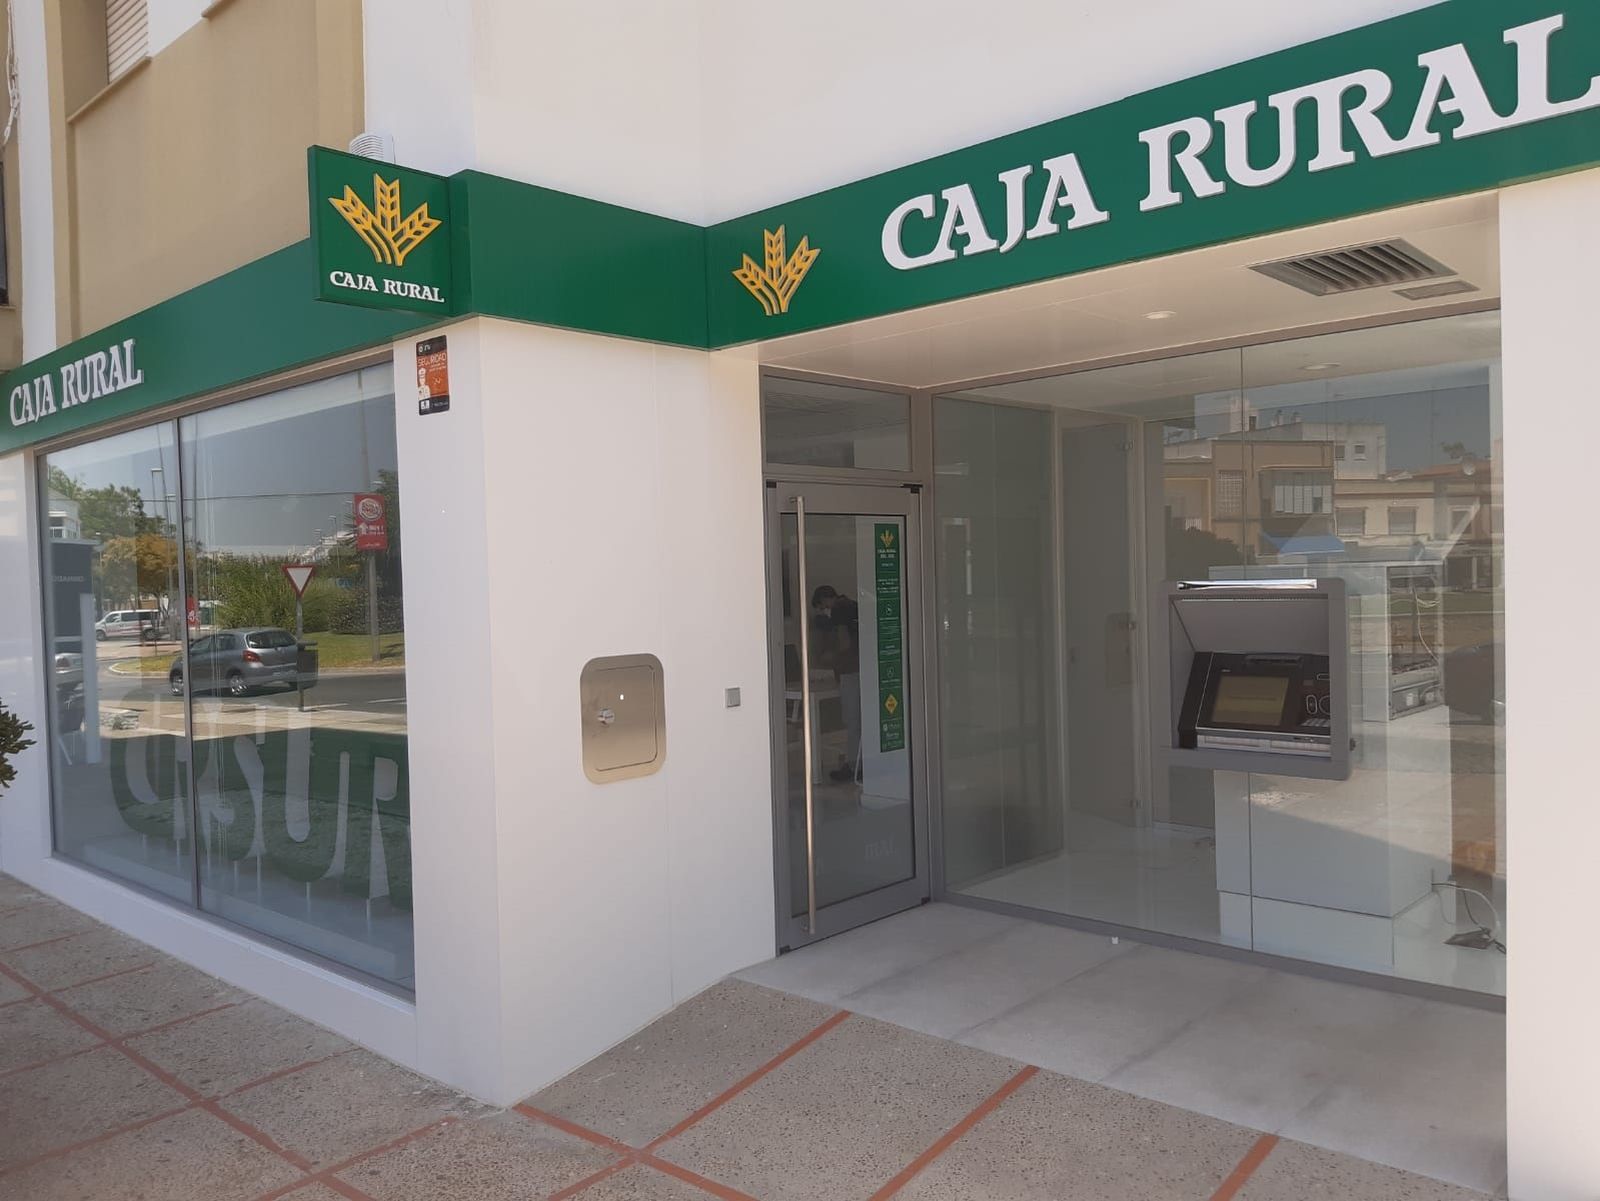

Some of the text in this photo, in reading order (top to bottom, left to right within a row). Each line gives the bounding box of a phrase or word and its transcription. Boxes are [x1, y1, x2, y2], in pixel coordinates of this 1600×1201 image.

[881, 13, 1600, 270] CAJA RURAL
[329, 270, 445, 303] CAJA RURAL
[9, 338, 144, 427] CAJA RURAL
